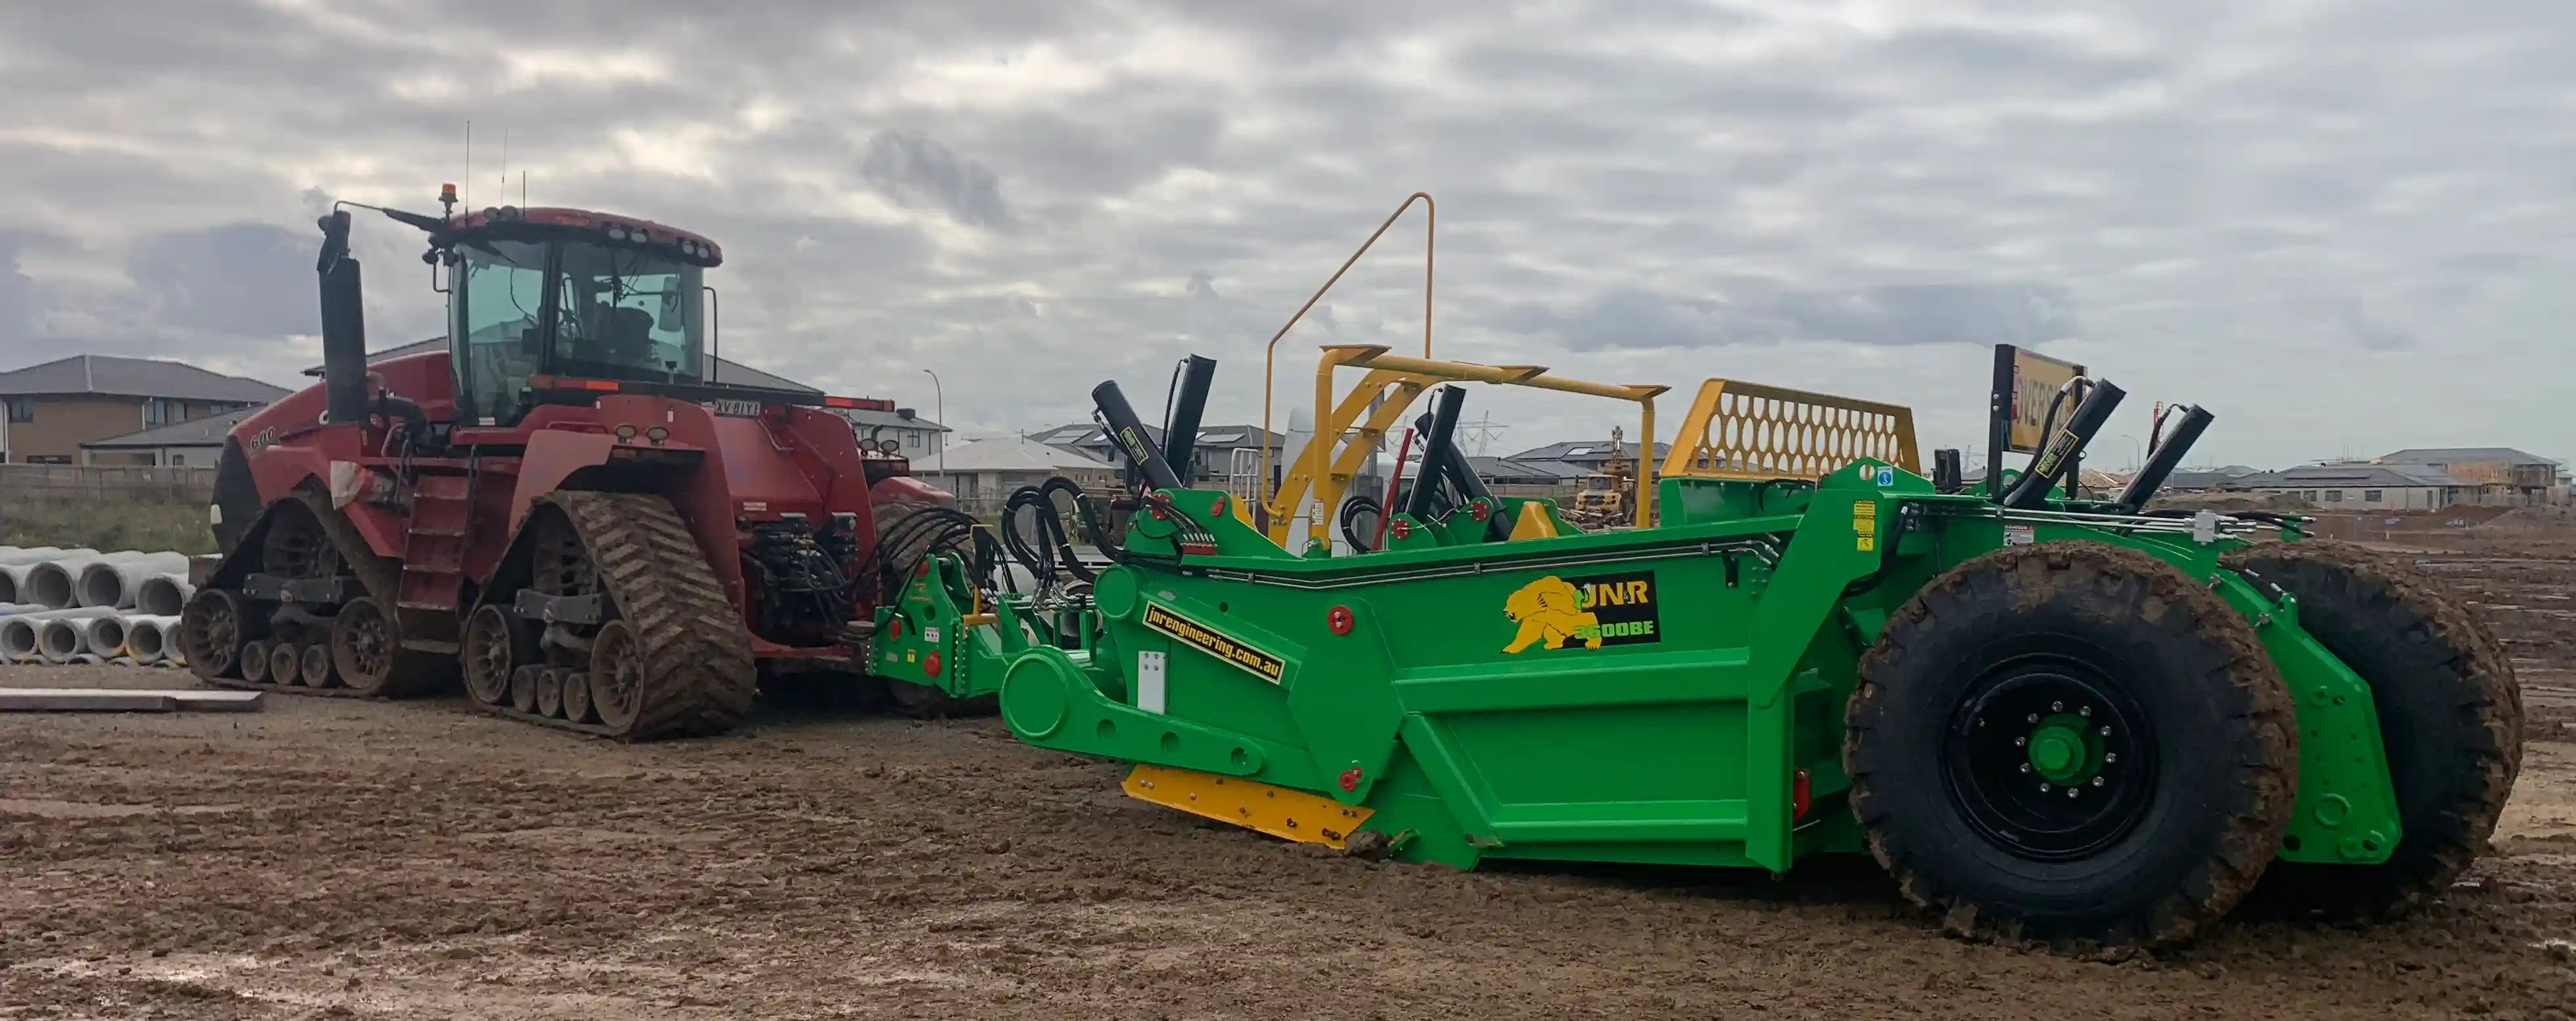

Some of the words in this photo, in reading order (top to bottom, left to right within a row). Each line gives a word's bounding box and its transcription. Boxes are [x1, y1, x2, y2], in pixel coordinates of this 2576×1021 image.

[250, 426, 275, 450] 600
[1574, 620, 1654, 639] 3600BE
[1147, 607, 1280, 677] jnrengineering.com.au
